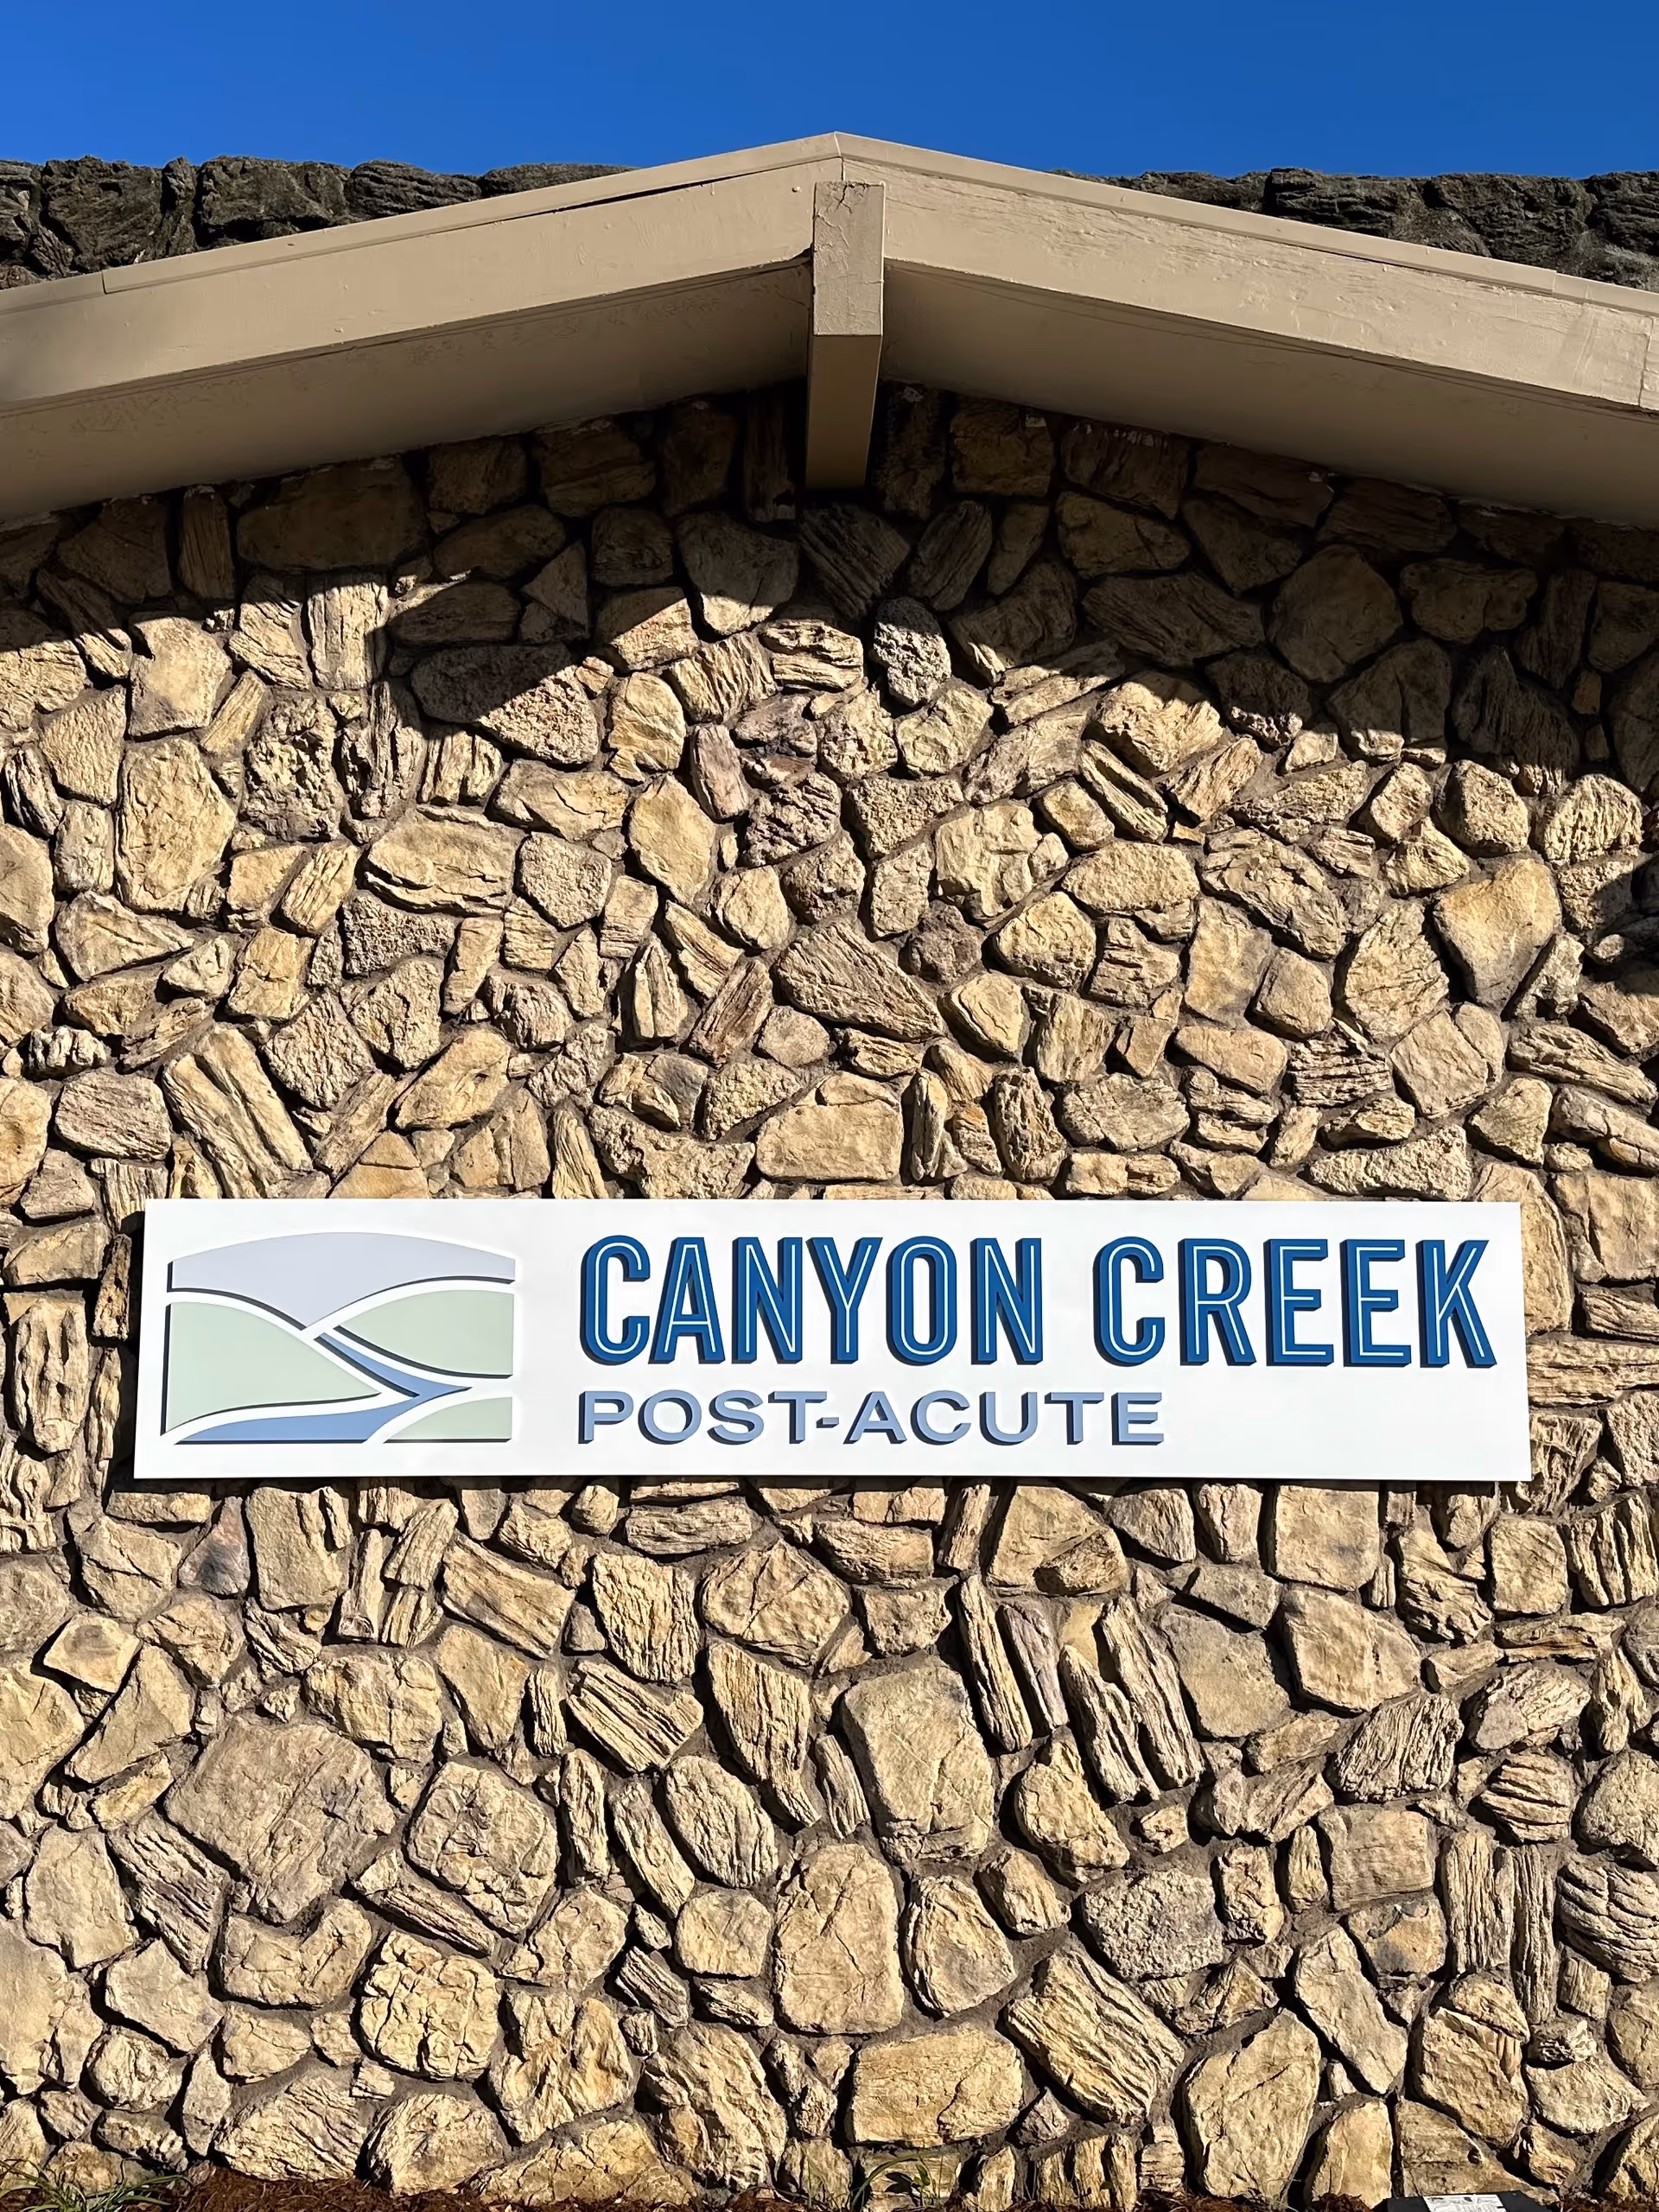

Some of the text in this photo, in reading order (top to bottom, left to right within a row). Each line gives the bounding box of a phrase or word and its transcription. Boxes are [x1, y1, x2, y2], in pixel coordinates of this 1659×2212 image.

[580, 1235, 1497, 1369] CANYON CREEK
[578, 1389, 1164, 1446] POST-ACUTE
